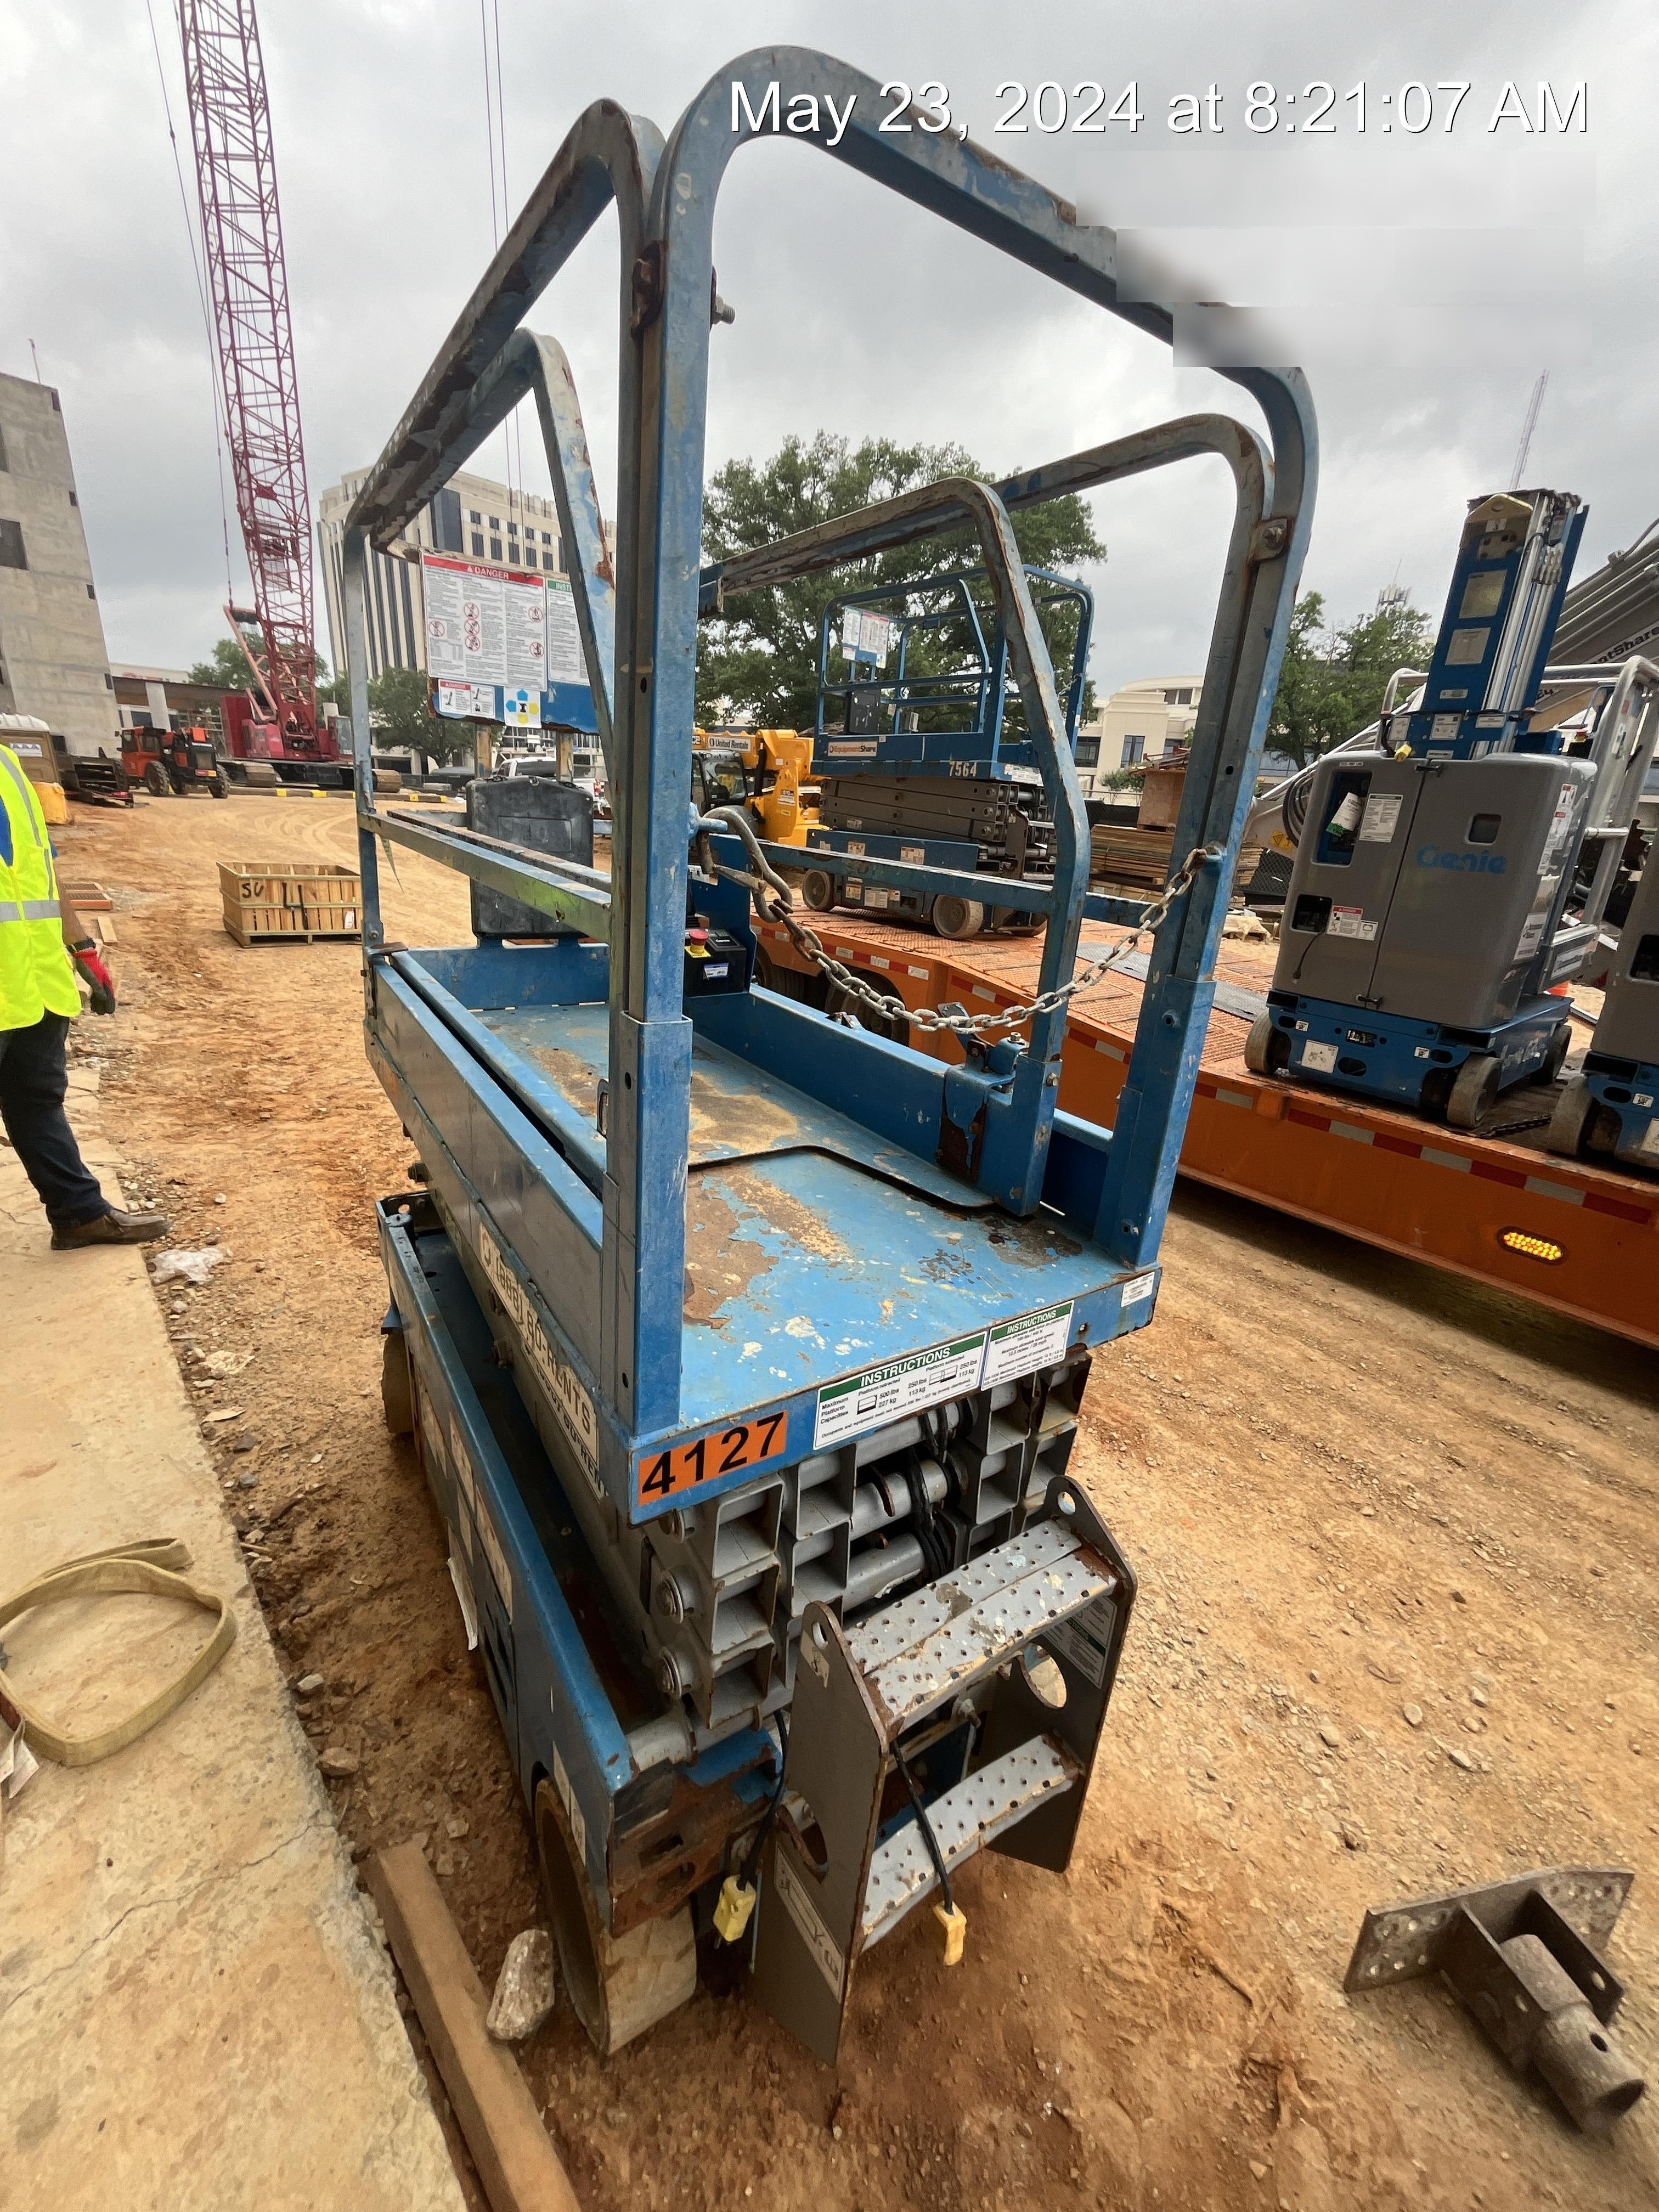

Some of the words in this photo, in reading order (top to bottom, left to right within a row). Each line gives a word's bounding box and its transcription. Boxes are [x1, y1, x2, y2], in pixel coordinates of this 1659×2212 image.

[474, 566, 510, 580] DANGER
[715, 739, 730, 748] United
[731, 740, 749, 749] Rentals
[834, 745, 877, 753] EquipmentShare
[949, 760, 978, 777] 7564
[1416, 844, 1508, 874] Genie
[1006, 1310, 1057, 1334] INSTRUCTIONS
[860, 1347, 951, 1387] INSTRUCTIONS
[960, 1362, 969, 1370] 250
[969, 1359, 978, 1367] lbs
[968, 1368, 975, 1376] kg
[918, 1378, 927, 1386] lbs
[889, 1387, 899, 1396] lbs
[918, 1386, 926, 1395] kg
[821, 1397, 849, 1410] Maximum
[878, 1400, 889, 1408] 227
[889, 1397, 897, 1406] kg
[820, 1410, 849, 1424] Capacities
[821, 1404, 845, 1417] Platform
[641, 1412, 785, 1494] 4127
